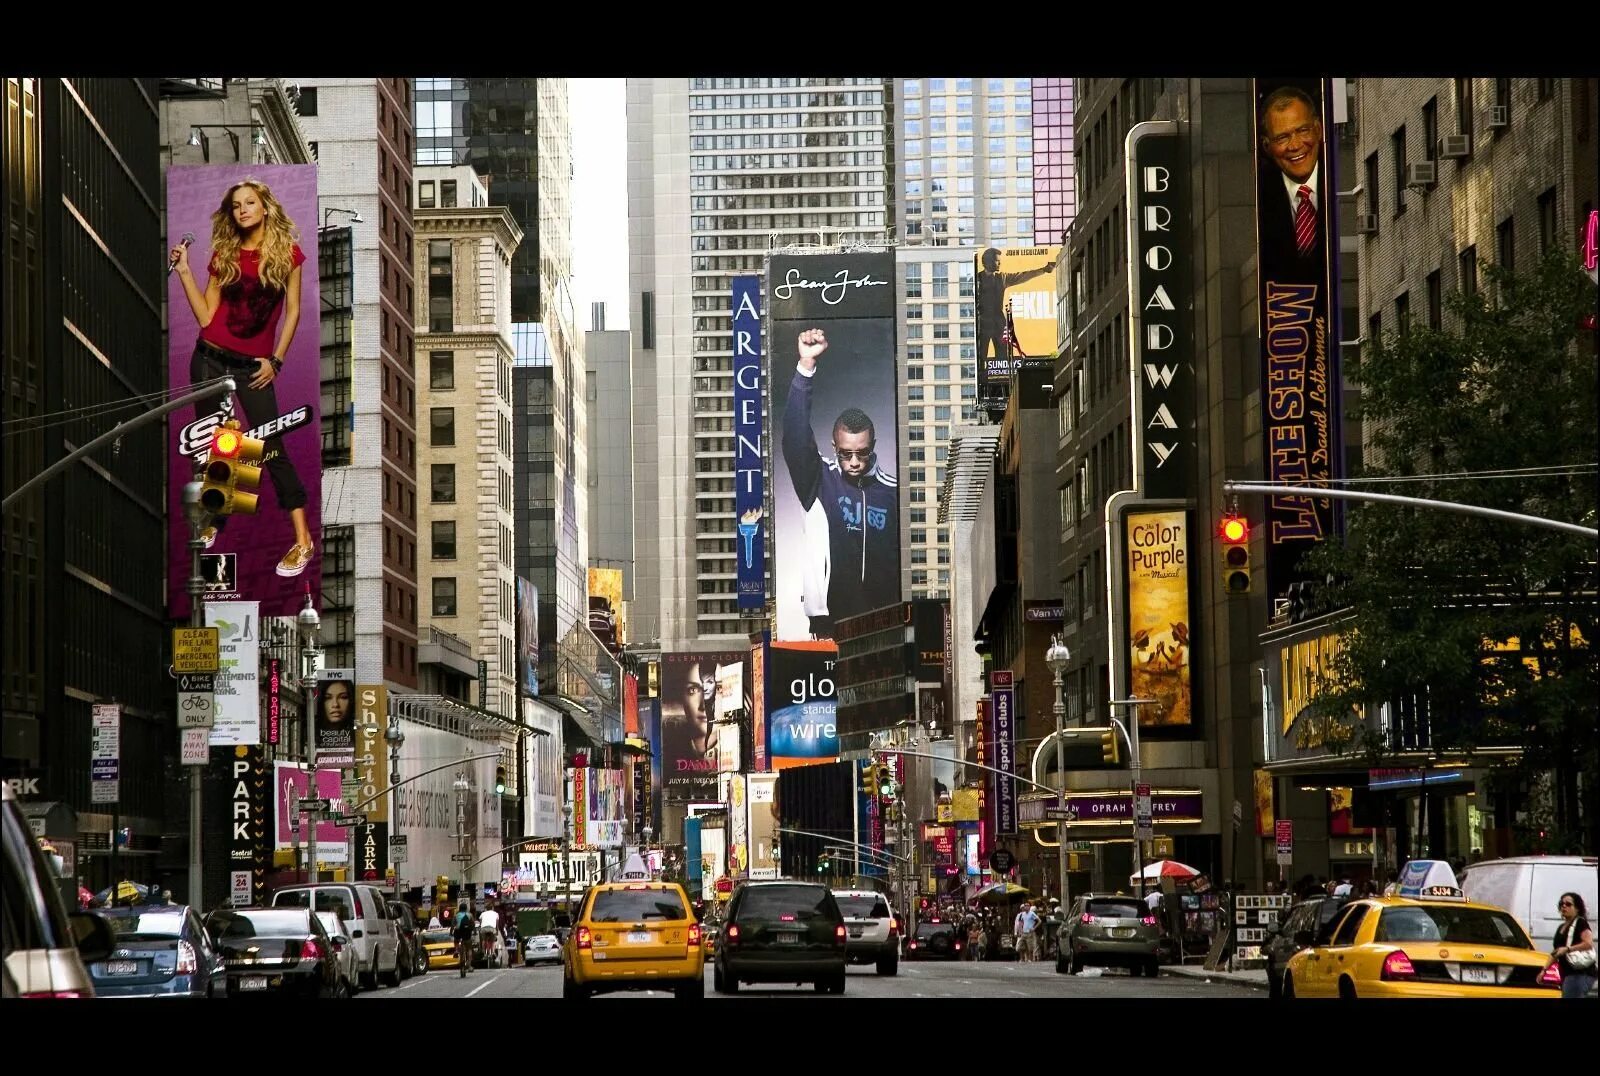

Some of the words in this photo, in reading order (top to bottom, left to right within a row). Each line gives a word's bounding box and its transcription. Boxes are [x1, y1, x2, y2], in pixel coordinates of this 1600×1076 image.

[774, 268, 828, 300] Sean
[821, 269, 888, 305] John
[1143, 166, 1179, 469] BROADWAY
[1266, 281, 1318, 420] SHOW
[987, 359, 1022, 370] SUNDYS
[1309, 316, 1327, 408] Letterman
[735, 291, 761, 493] ARGENT
[180, 406, 308, 455] SHERS
[1309, 410, 1328, 466] David
[1133, 523, 1181, 547] Color
[1131, 542, 1185, 571] Purple
[1151, 568, 1181, 579] Musical
[1032, 609, 1051, 618] Van
[1053, 609, 1065, 617] W
[175, 652, 216, 660] EMERGENCY
[669, 654, 704, 662] GLENN
[179, 660, 213, 669] VEHICLES
[327, 671, 343, 679] NYC
[998, 694, 1010, 728] clubs
[185, 715, 206, 723] ONLY
[187, 732, 203, 740] TOW
[320, 729, 350, 738] beauty
[322, 734, 351, 743] capital
[183, 741, 206, 749] AWAY
[361, 689, 378, 812] Sheraton
[998, 730, 1011, 770] sports
[183, 751, 206, 759] ZONE
[317, 756, 353, 764] COSMOPOLITAN
[999, 773, 1011, 801] york
[232, 761, 250, 840] PARK
[1071, 804, 1080, 813] by
[1092, 804, 1126, 813] OPRAH
[1131, 803, 1177, 812] FREY
[1000, 804, 1011, 830] new
[364, 823, 377, 870] PARK
[235, 879, 248, 887] 24
[1432, 886, 1451, 896] 5J34
